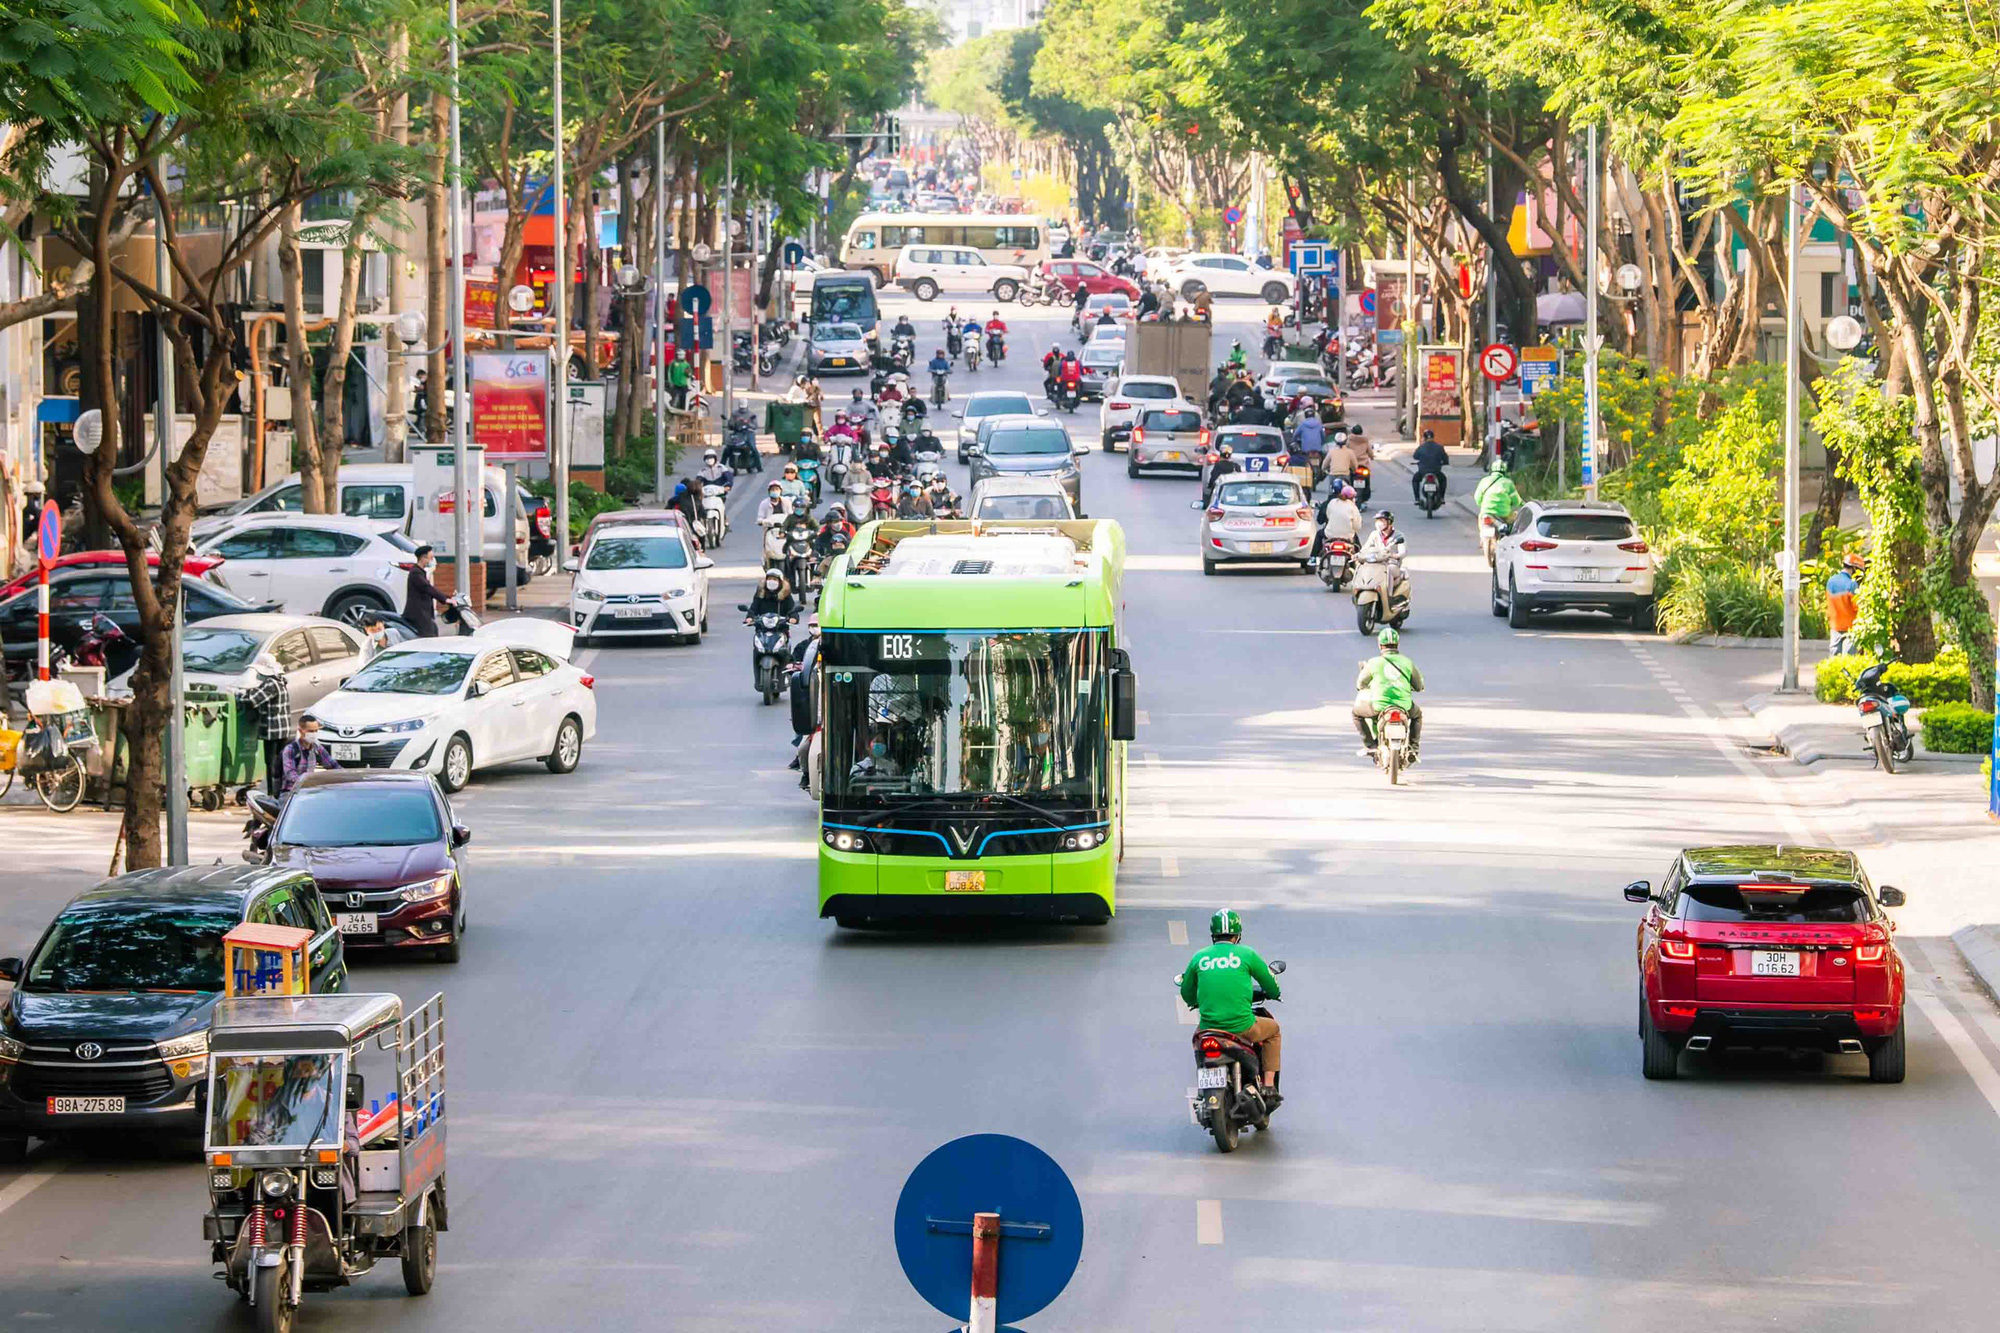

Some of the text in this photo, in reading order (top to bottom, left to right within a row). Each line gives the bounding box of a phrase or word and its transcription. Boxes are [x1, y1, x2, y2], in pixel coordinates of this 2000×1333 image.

[1250, 459, 1264, 471] G7
[883, 634, 912, 659] E03
[348, 914, 366, 924] 34A
[341, 923, 374, 933] 445.65
[1198, 952, 1241, 971] Grab
[1766, 952, 1787, 963] 30H
[1757, 963, 1795, 974] 016.62
[1199, 1078, 1226, 1088] 094.49
[56, 1098, 124, 1113] 98A-275.89
